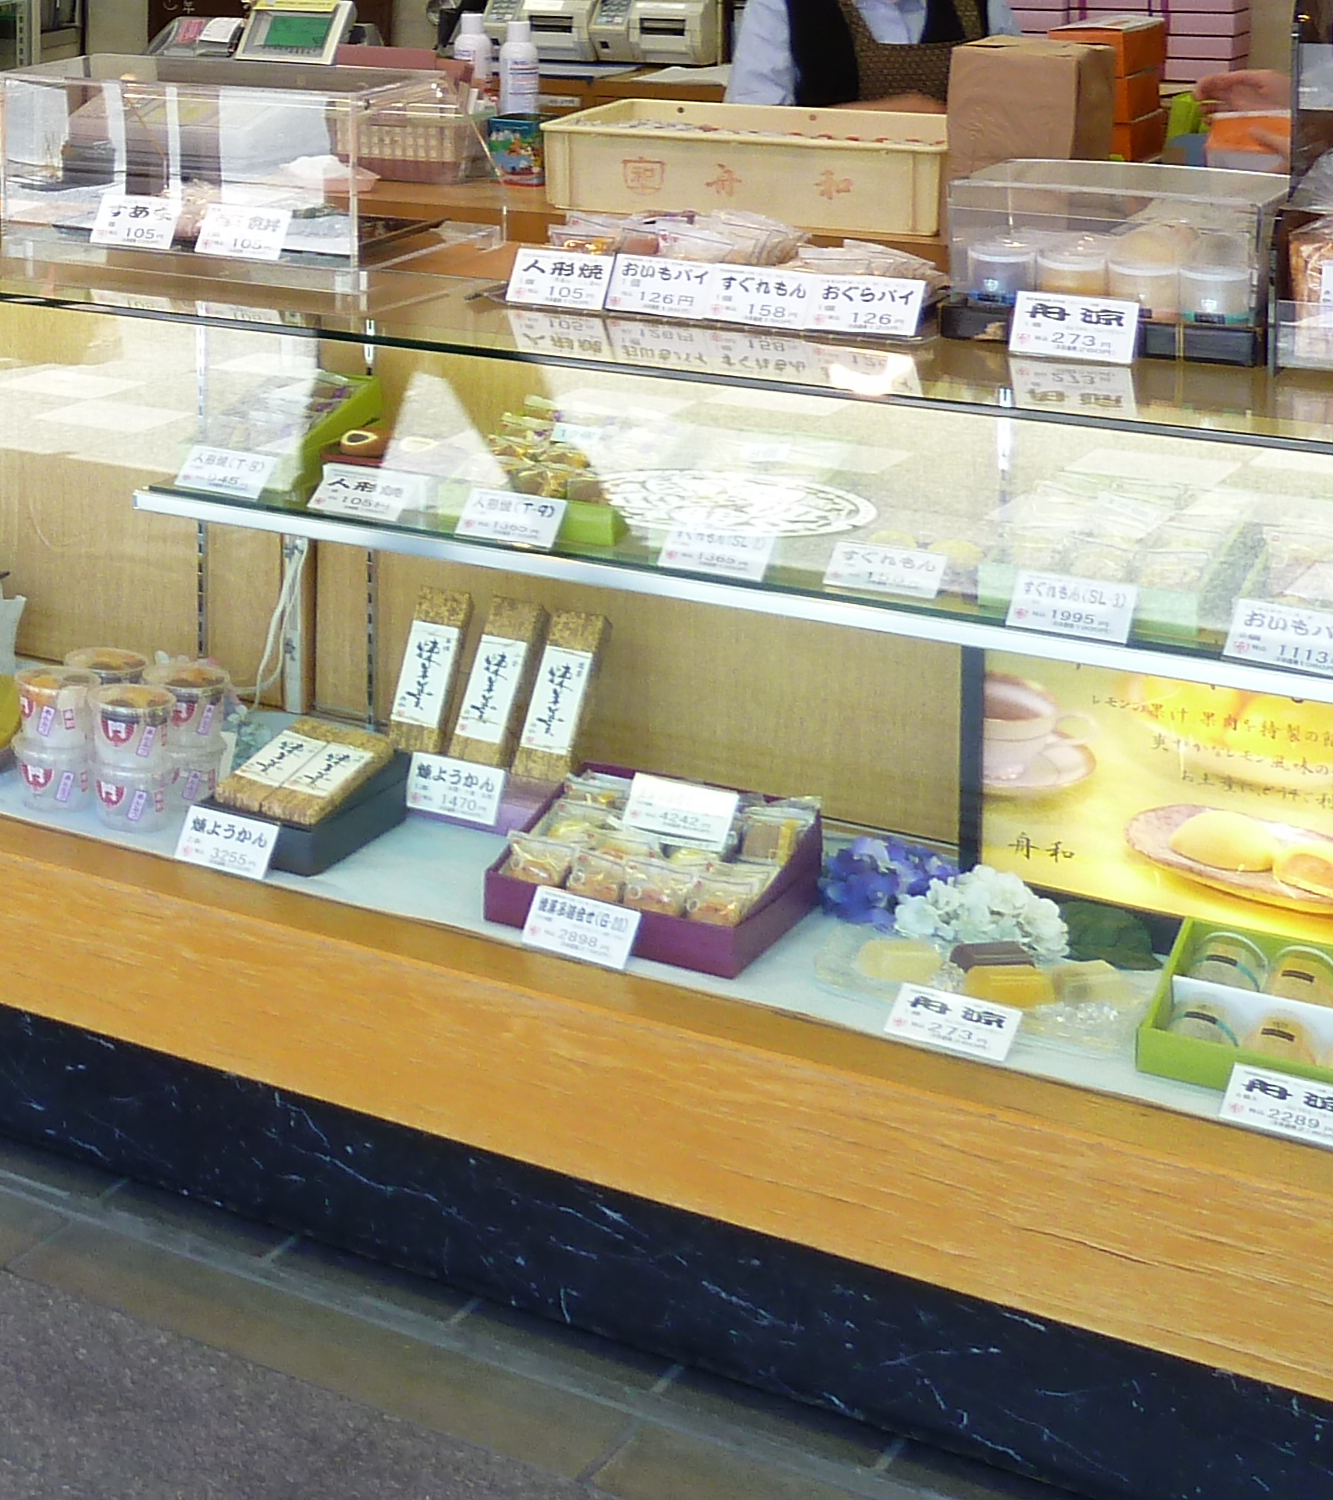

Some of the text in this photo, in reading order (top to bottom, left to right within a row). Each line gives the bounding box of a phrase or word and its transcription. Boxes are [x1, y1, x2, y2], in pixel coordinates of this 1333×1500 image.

[522, 259, 604, 280] 人形焼
[548, 285, 595, 299] 105円
[722, 276, 807, 299] すぐれもん
[639, 291, 695, 307] 126円
[747, 303, 798, 319] 158円
[851, 312, 905, 325] 126円
[1050, 332, 1112, 349] 273円
[842, 549, 936, 573] すぐれもん
[1049, 608, 1110, 629] 1995円
[440, 794, 488, 813] 1470円
[1008, 830, 1076, 864] 舟和
[556, 928, 611, 952] 2898円
[927, 1021, 989, 1045] 273円
